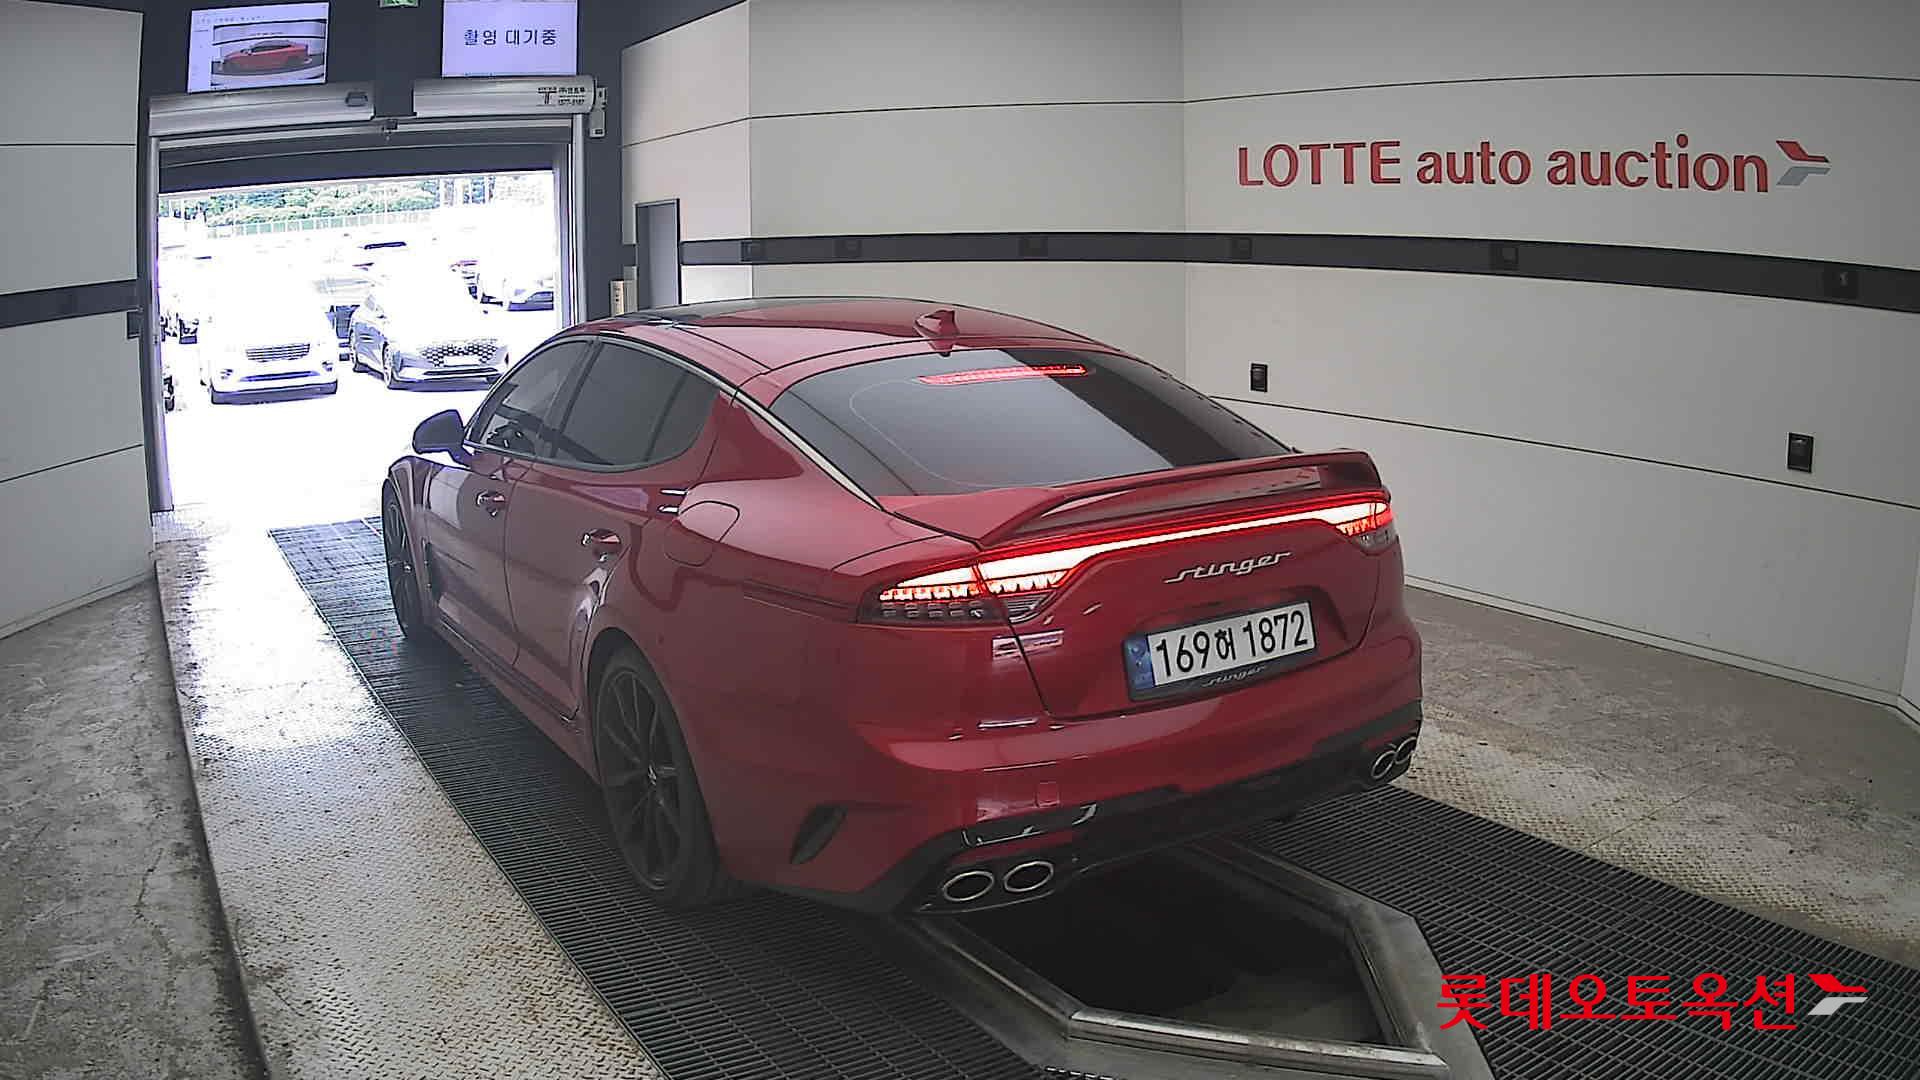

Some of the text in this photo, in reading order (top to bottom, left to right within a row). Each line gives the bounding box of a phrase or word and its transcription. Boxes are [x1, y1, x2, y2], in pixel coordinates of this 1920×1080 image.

[505, 29, 557, 46] 대기중
[1238, 134, 1769, 193] LOTTE auto auction
[1164, 551, 1292, 584] stinger
[1155, 609, 1309, 678] 169허 1872
